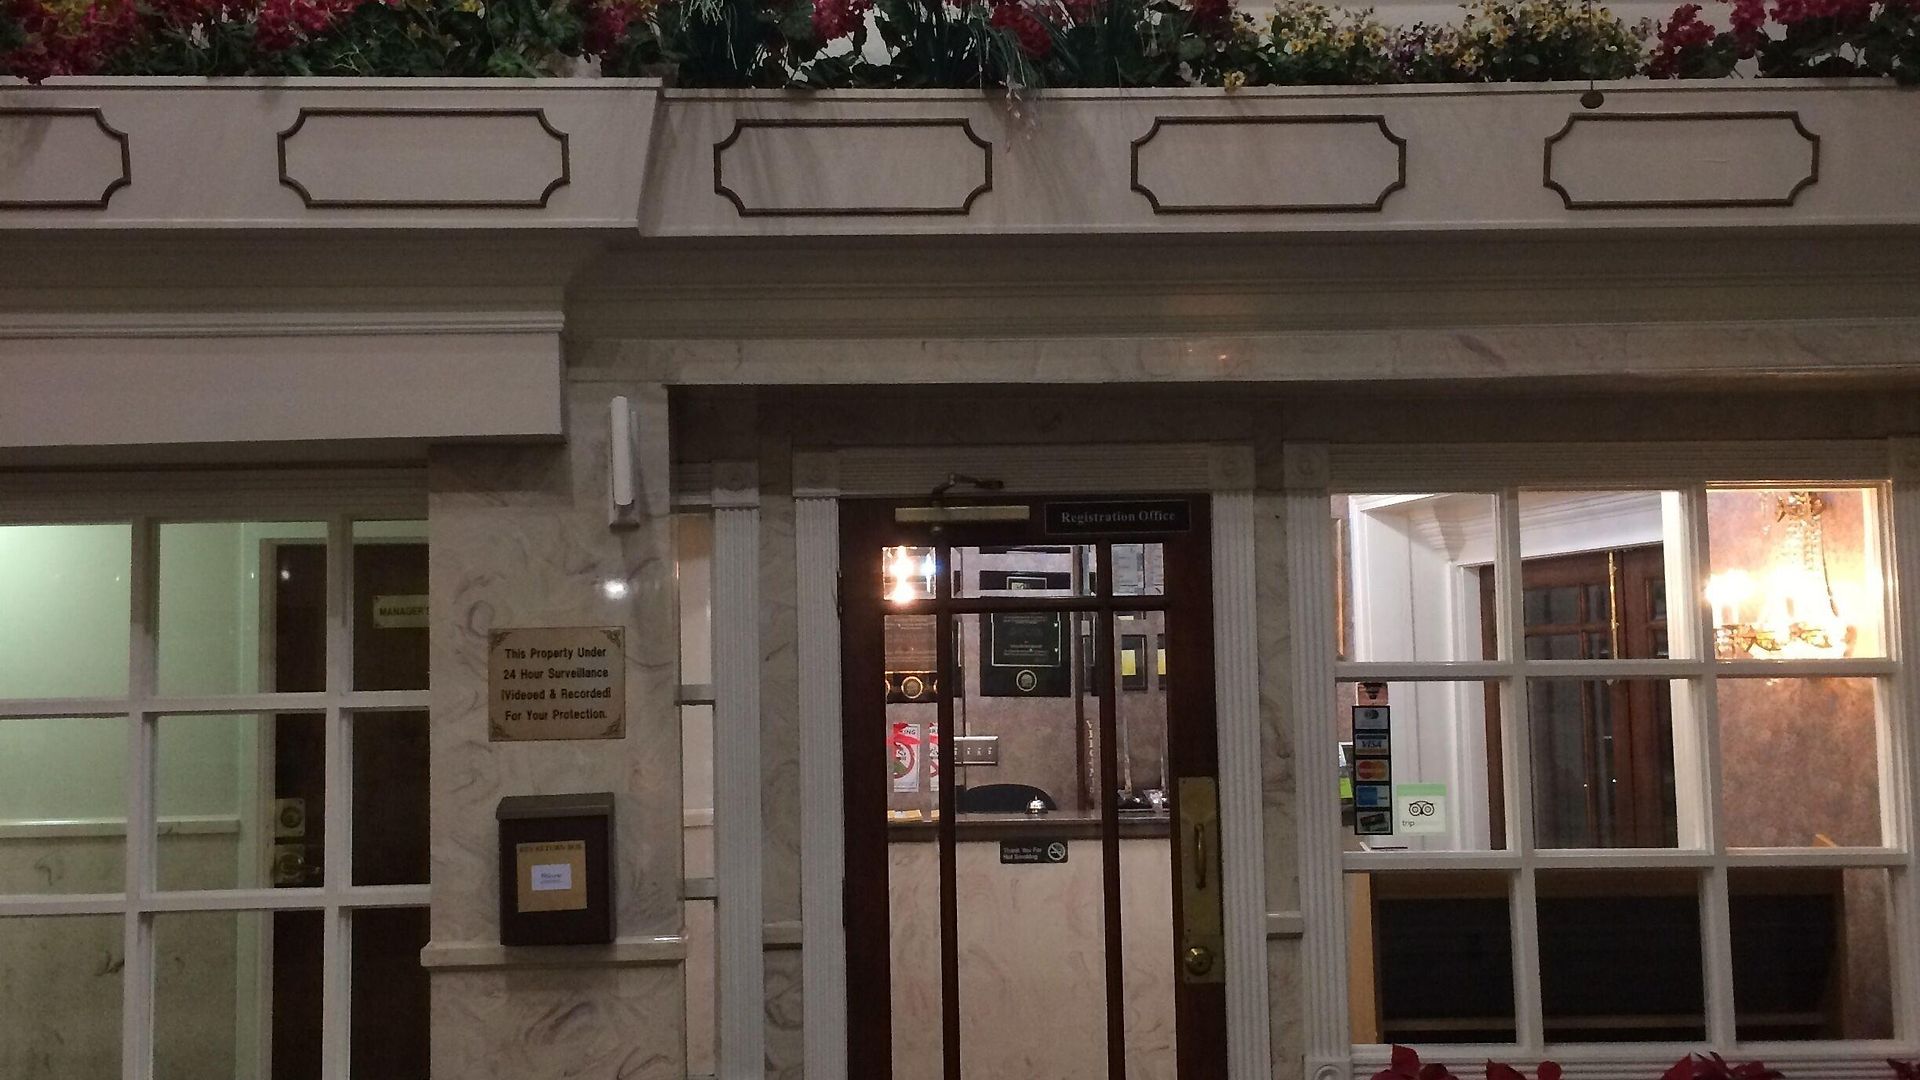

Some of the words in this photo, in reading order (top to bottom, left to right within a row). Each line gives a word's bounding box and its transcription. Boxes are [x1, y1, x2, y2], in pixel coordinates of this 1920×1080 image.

[1061, 511, 1135, 525] Registration
[1138, 510, 1176, 522] Office
[505, 648, 526, 659] This
[530, 647, 574, 660] Property
[577, 646, 607, 658] Under
[503, 669, 516, 680] 24
[520, 669, 544, 680] Hour
[548, 667, 609, 679] Surveillance
[549, 688, 557, 700] &
[505, 711, 522, 721] For
[527, 710, 548, 721] Your
[1362, 740, 1382, 748] VISA
[1402, 820, 1415, 828] trip
